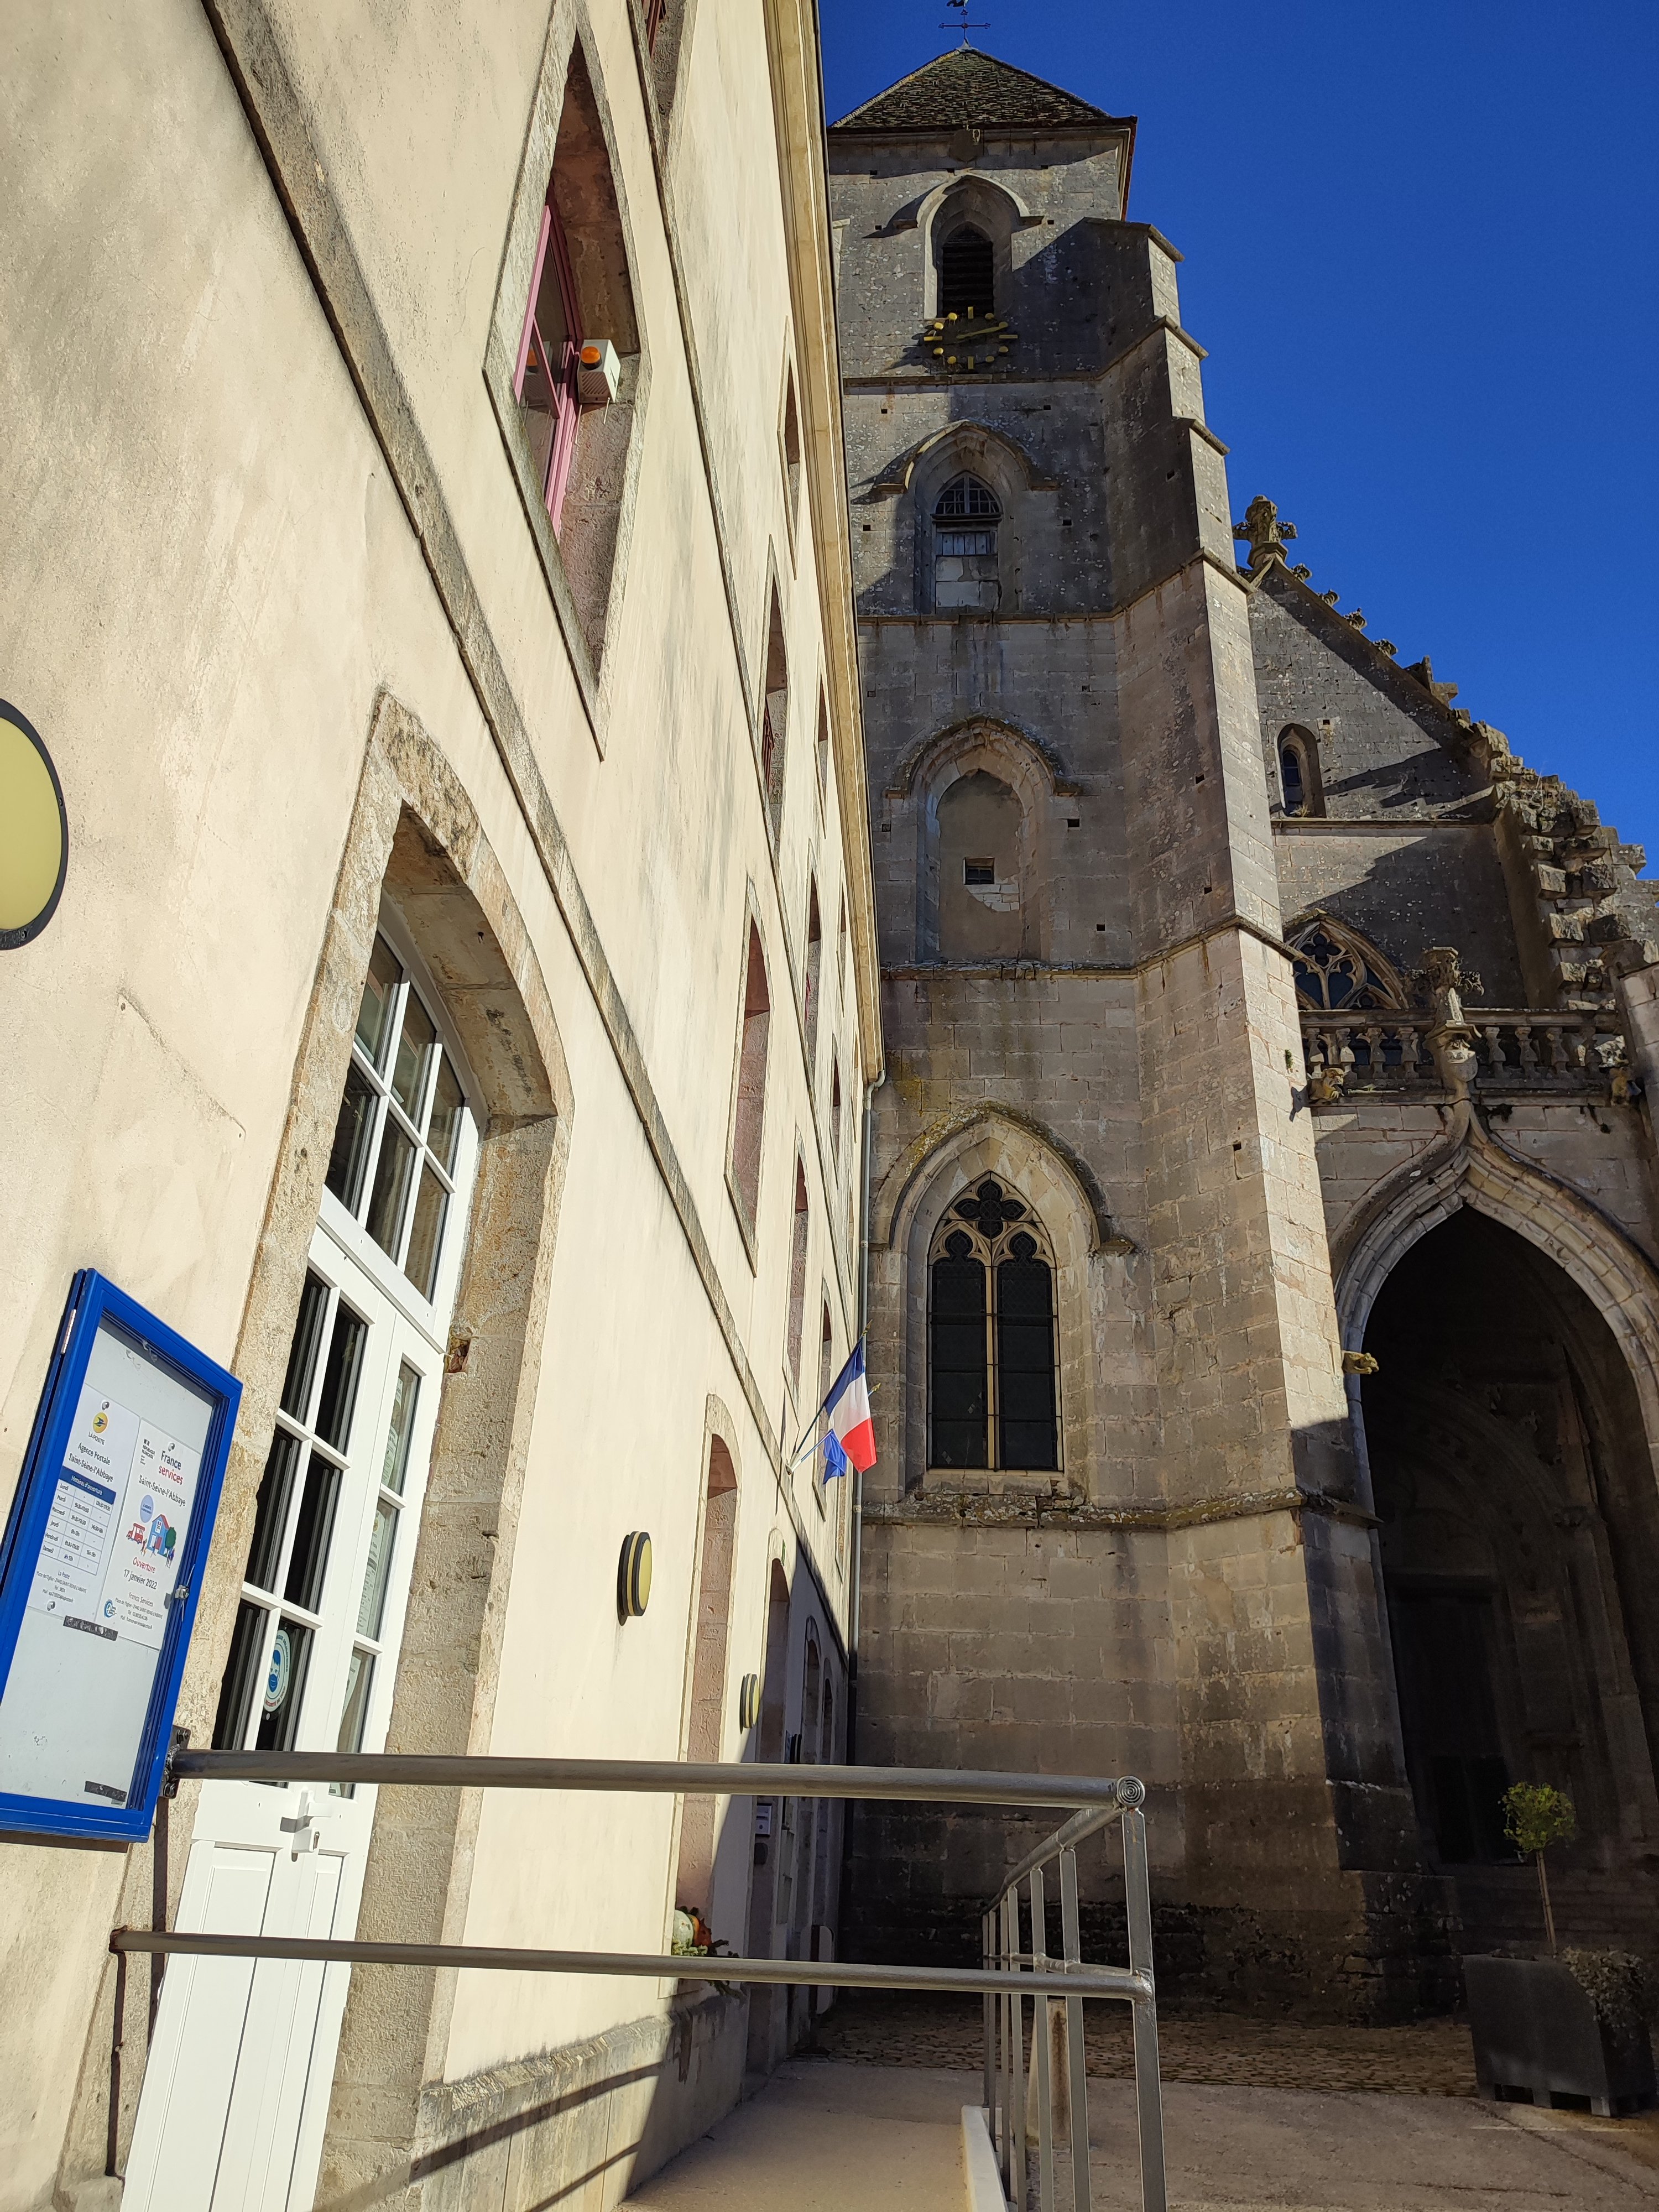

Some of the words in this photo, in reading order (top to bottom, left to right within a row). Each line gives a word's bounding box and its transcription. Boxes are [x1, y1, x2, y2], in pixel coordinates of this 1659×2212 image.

[93, 1434, 105, 1445] POSTE
[77, 1442, 93, 1457] Agence
[94, 1451, 111, 1465] Postale
[160, 1450, 181, 1470] France
[69, 1453, 113, 1483] Saint-Seine-l'Abbaye
[158, 1465, 183, 1485] services
[139, 1474, 186, 1507] Saint-Seine-l'Abbaye
[133, 1557, 156, 1574] Ouverture
[124, 1569, 130, 1578] 17
[128, 1571, 145, 1585] janvier
[145, 1578, 158, 1589] 2022
[128, 1592, 140, 1602] France
[140, 1596, 154, 1607] Services
